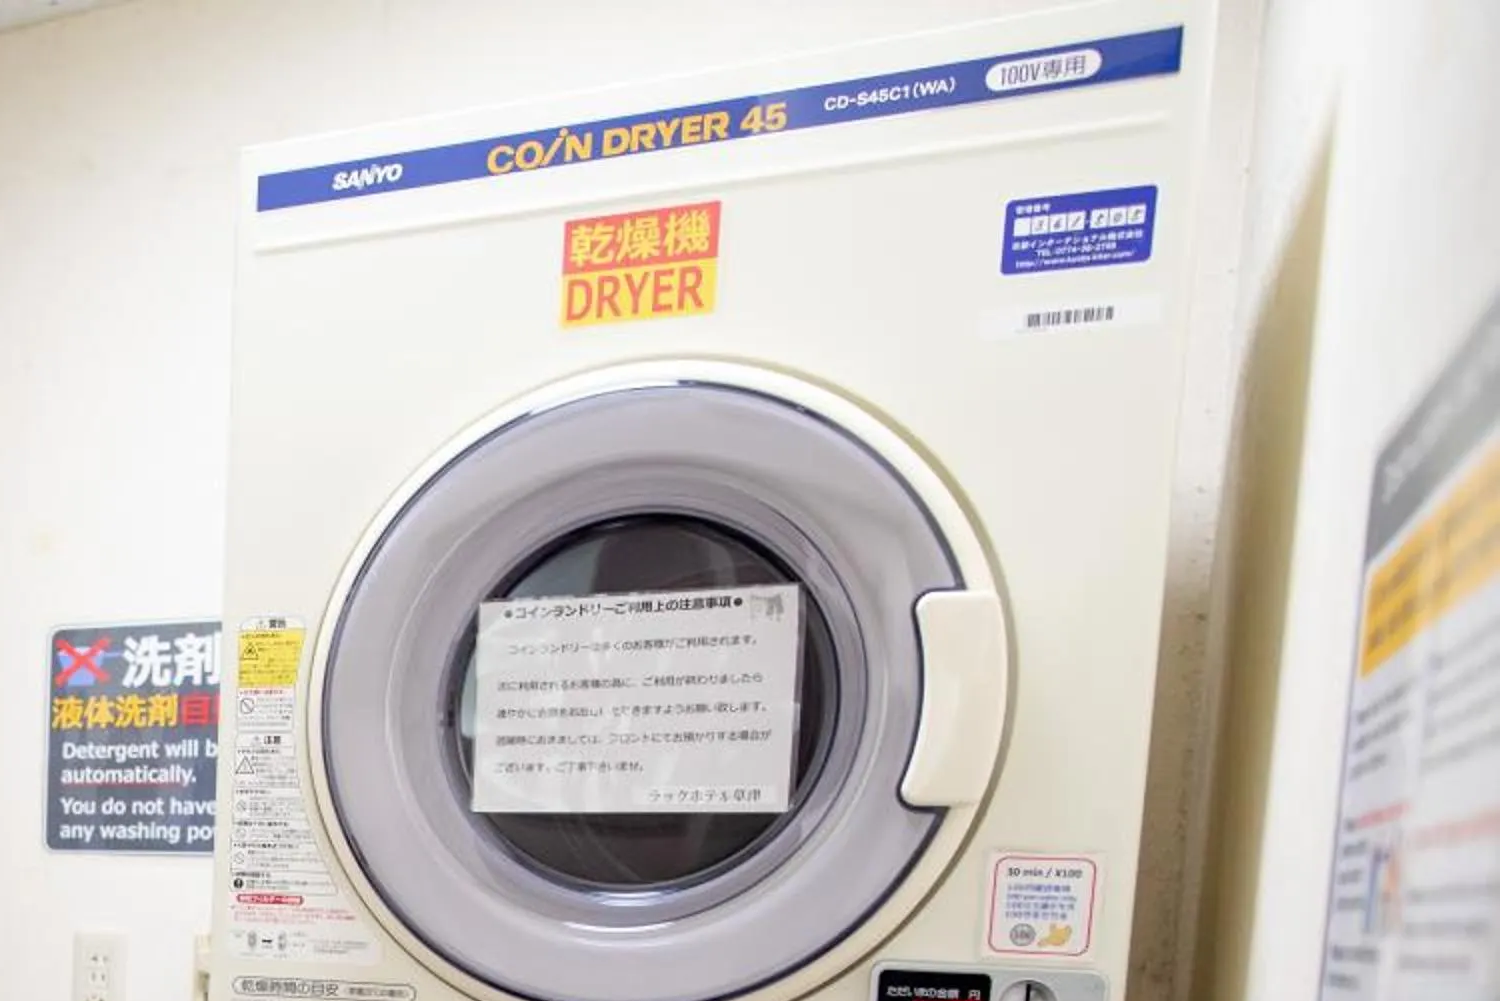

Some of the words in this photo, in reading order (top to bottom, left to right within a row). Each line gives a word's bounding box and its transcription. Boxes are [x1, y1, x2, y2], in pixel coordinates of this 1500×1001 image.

[1000, 55, 1087, 87] 100V専用
[332, 163, 402, 191] SANYO
[486, 127, 593, 176] COIN
[602, 104, 729, 156] DRYER
[740, 102, 787, 133] 45
[824, 77, 955, 111] CD-S45C1(WA)
[571, 209, 711, 267] 乾燥機
[565, 266, 704, 321] DRYER
[52, 692, 221, 729] 液体洗剤自
[62, 741, 159, 763] Detergent
[166, 739, 198, 758] will
[61, 762, 197, 785] automatically.
[61, 798, 97, 816] You
[102, 798, 126, 815] do
[131, 799, 164, 815] not
[60, 826, 93, 843] any
[100, 823, 179, 843] washing
[187, 825, 215, 843] po
